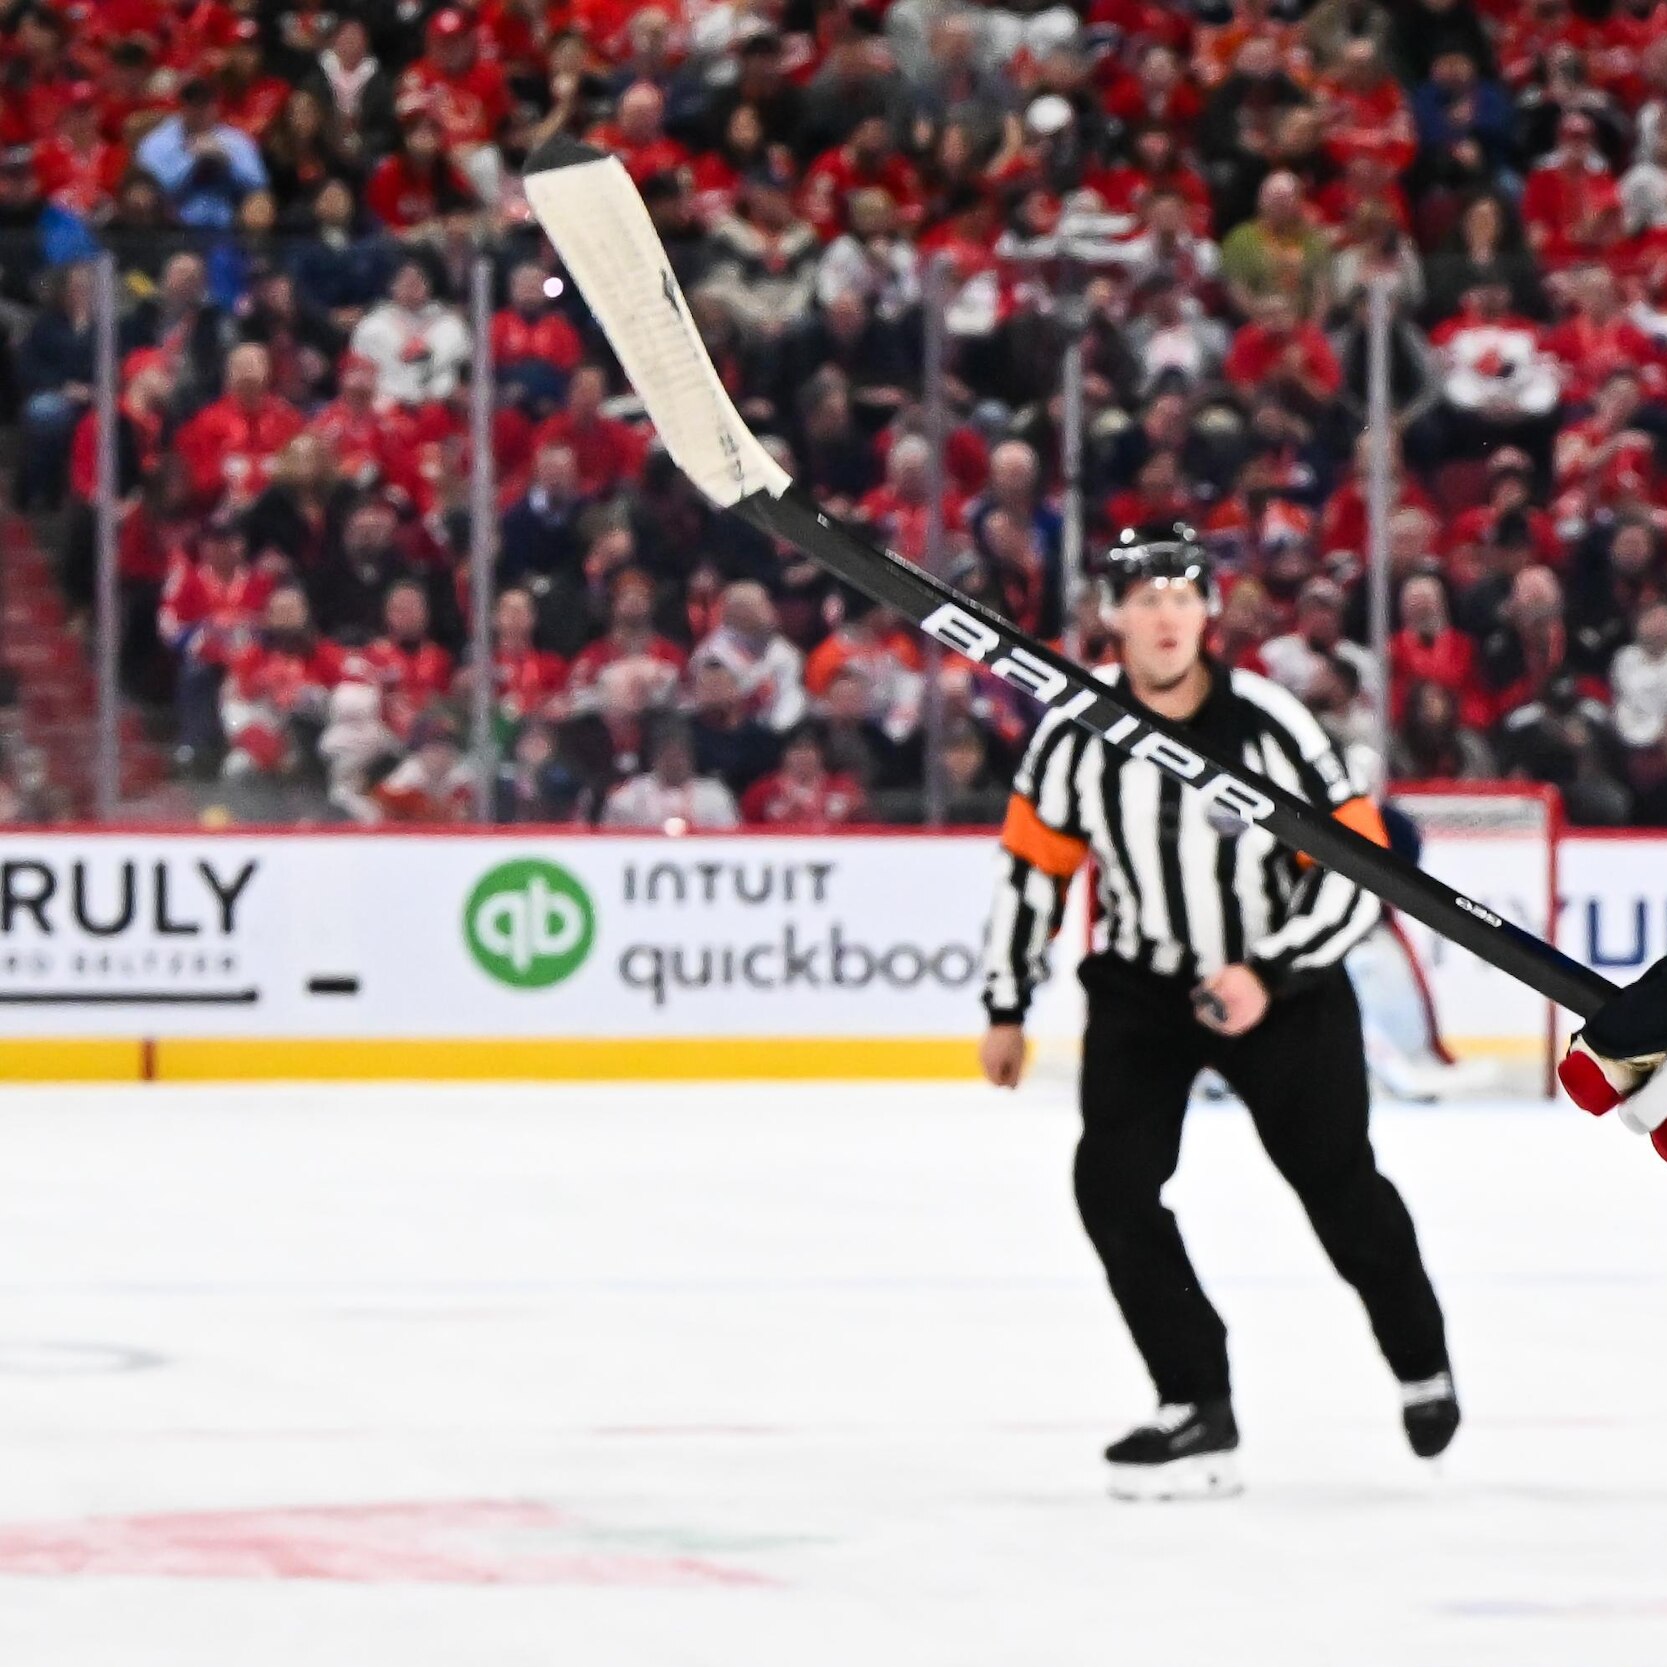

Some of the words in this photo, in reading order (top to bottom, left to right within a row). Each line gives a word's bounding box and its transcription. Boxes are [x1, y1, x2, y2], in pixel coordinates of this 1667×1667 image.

[920, 602, 1276, 824] BAUER
[2, 860, 258, 936] RULY
[621, 861, 838, 904] INTUIT
[475, 876, 588, 974] qb
[617, 922, 992, 1005] quickboo
